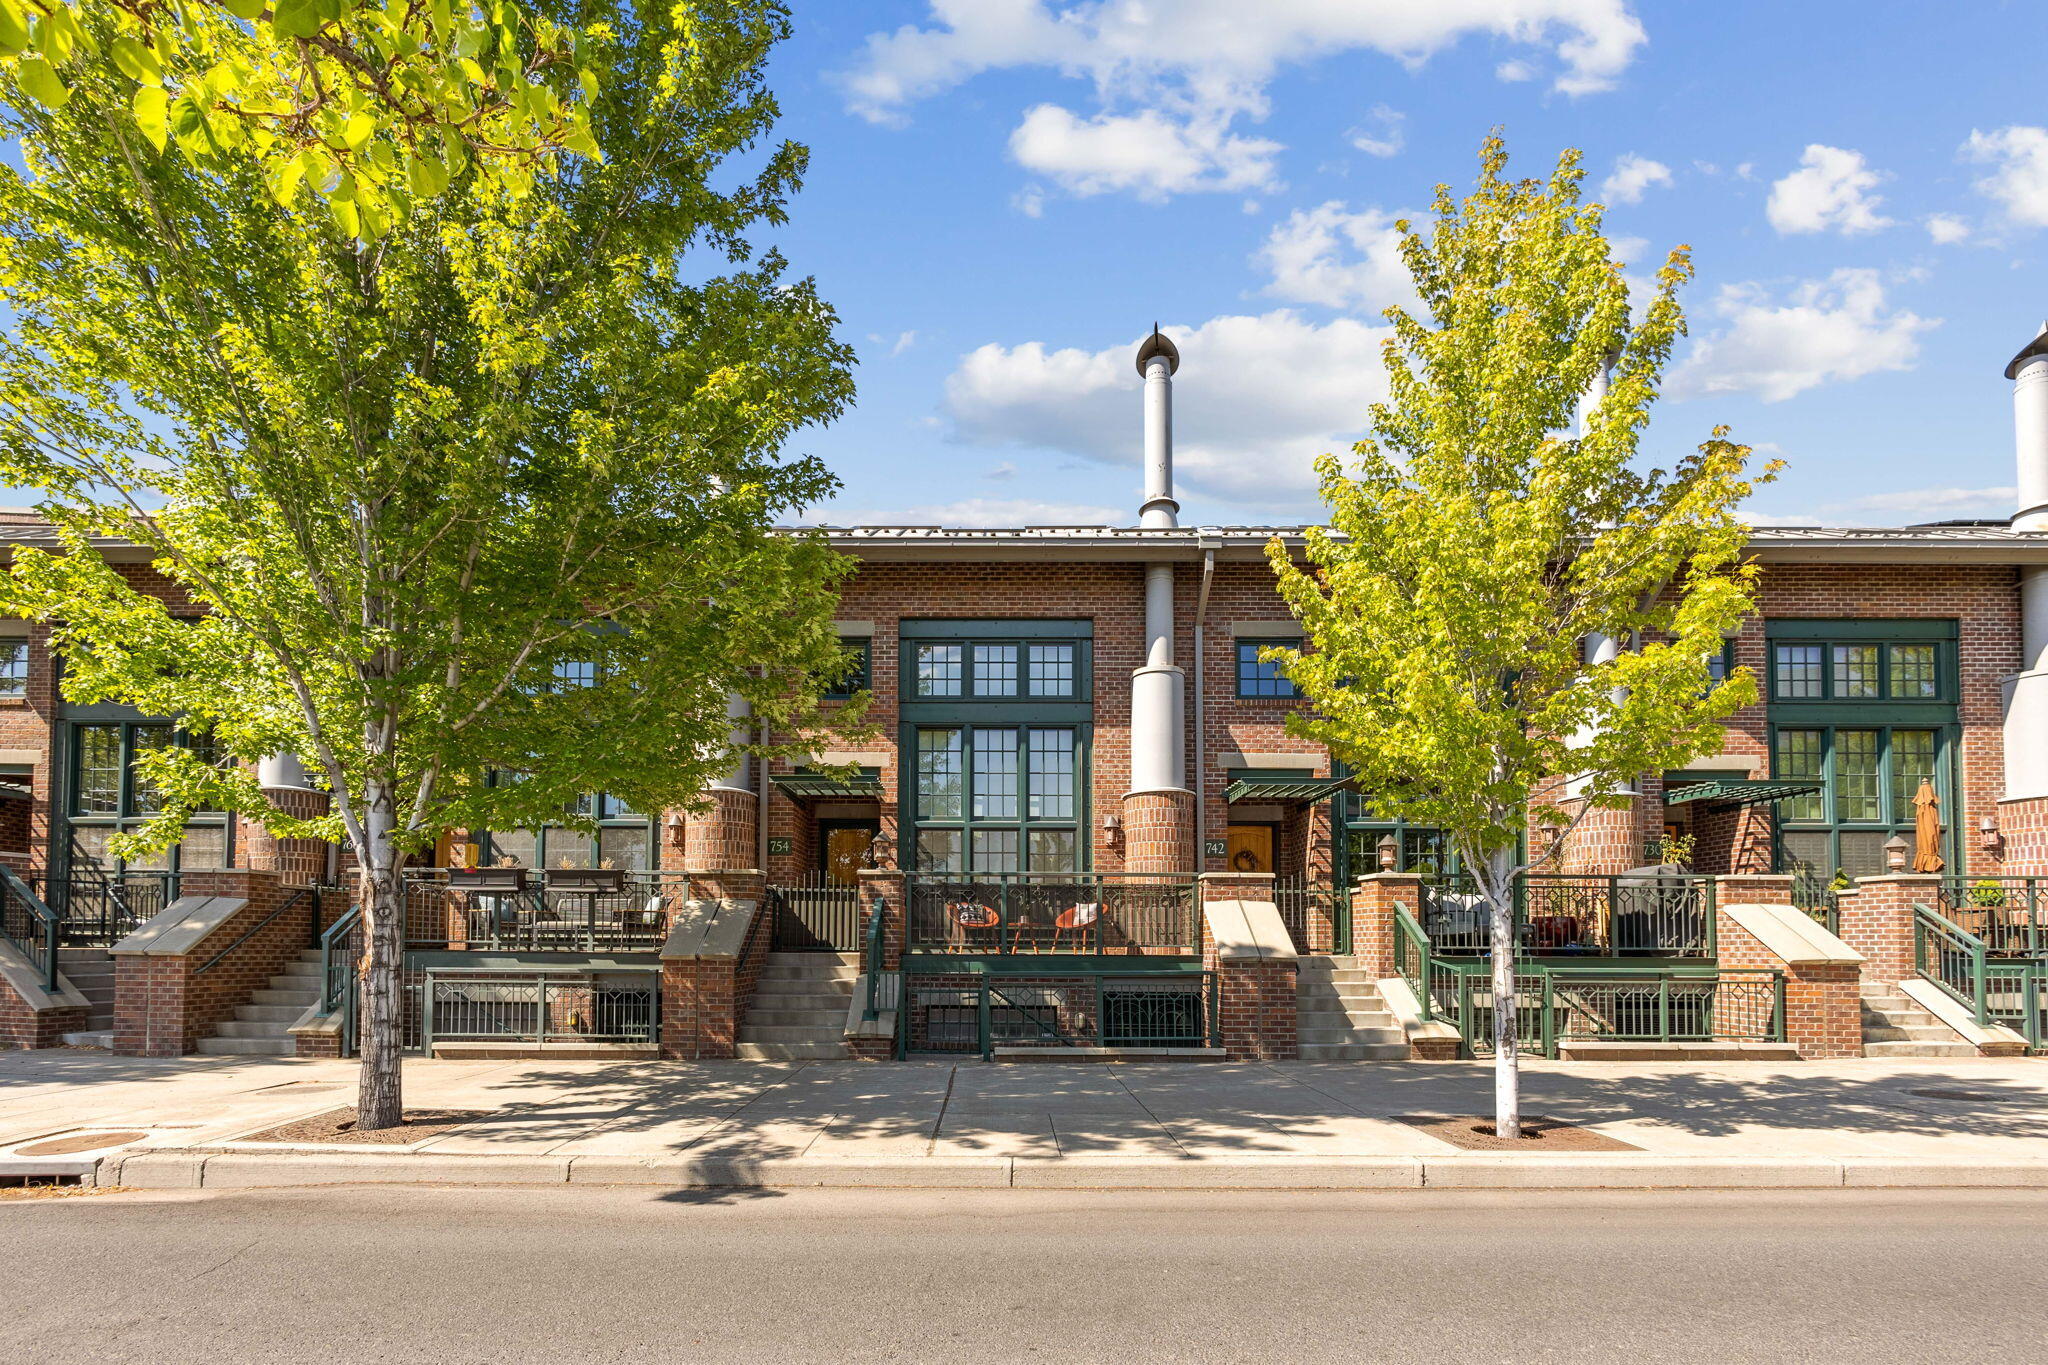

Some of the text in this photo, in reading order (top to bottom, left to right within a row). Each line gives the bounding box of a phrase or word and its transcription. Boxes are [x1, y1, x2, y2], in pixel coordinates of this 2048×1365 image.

[342, 839, 355, 849] 76
[770, 841, 789, 852] 754
[1206, 843, 1225, 854] 742
[1644, 844, 1662, 855] 730
